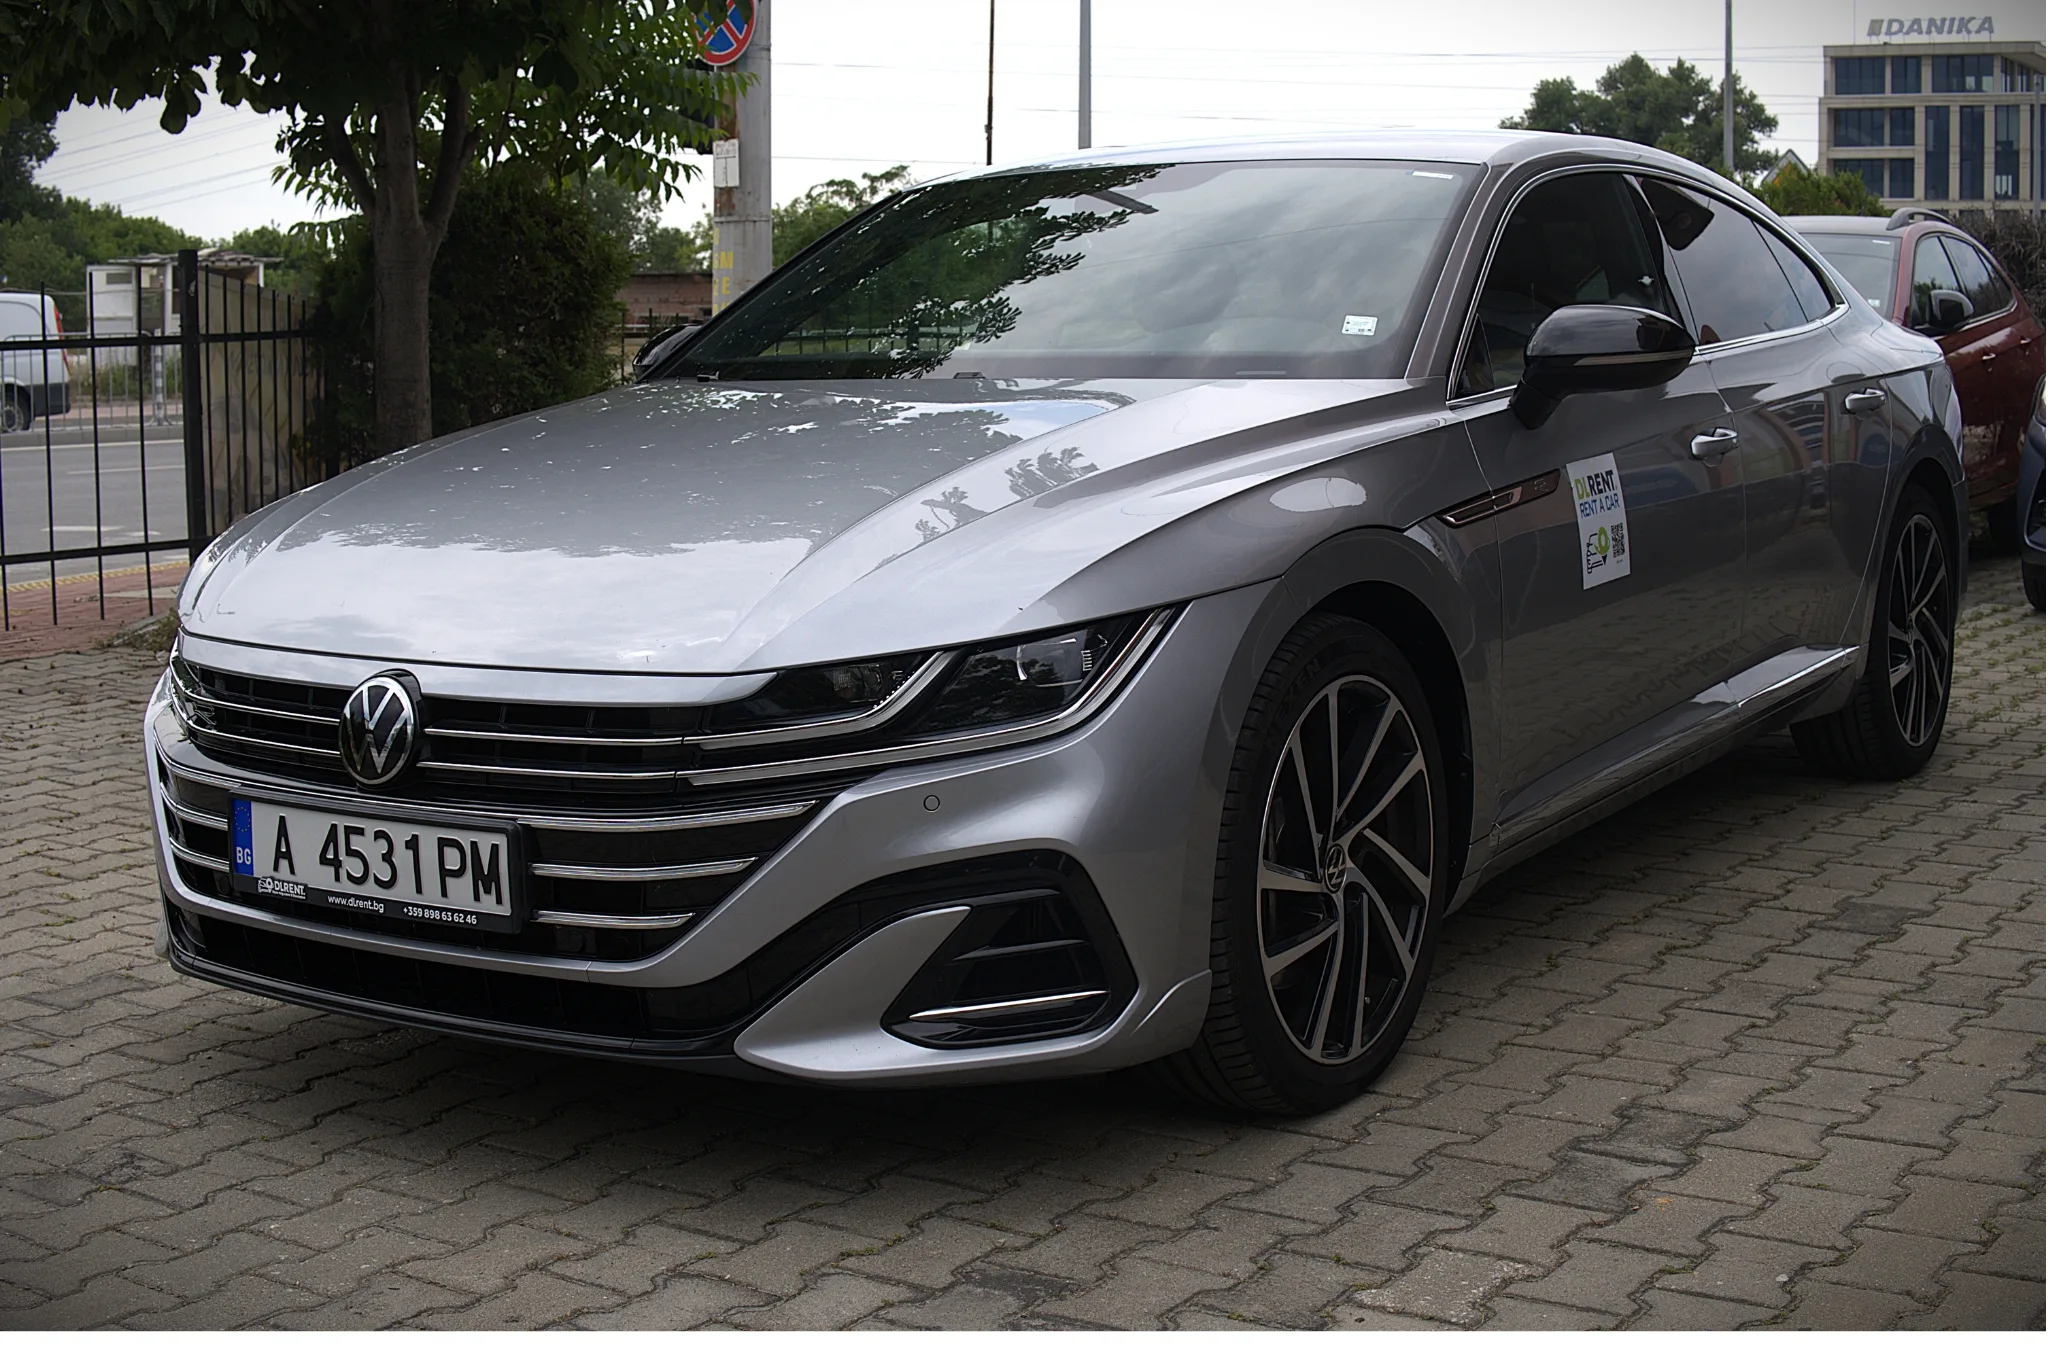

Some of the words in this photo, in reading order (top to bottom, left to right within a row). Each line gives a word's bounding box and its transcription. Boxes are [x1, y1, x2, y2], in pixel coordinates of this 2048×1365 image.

[1884, 16, 1994, 36] DANIKA
[1579, 499, 1600, 518] RENT
[1600, 498, 1606, 513] A
[1606, 494, 1620, 511] CAR
[236, 846, 252, 865] BG
[272, 813, 297, 876] A
[318, 821, 423, 896] 4531
[436, 836, 504, 905] PM
[327, 895, 384, 913] www.dlrent.bg
[403, 906, 423, 917] +359
[424, 909, 440, 920] 898
[441, 911, 452, 922] 63
[453, 913, 464, 923] 62
[465, 914, 477, 925] 46
